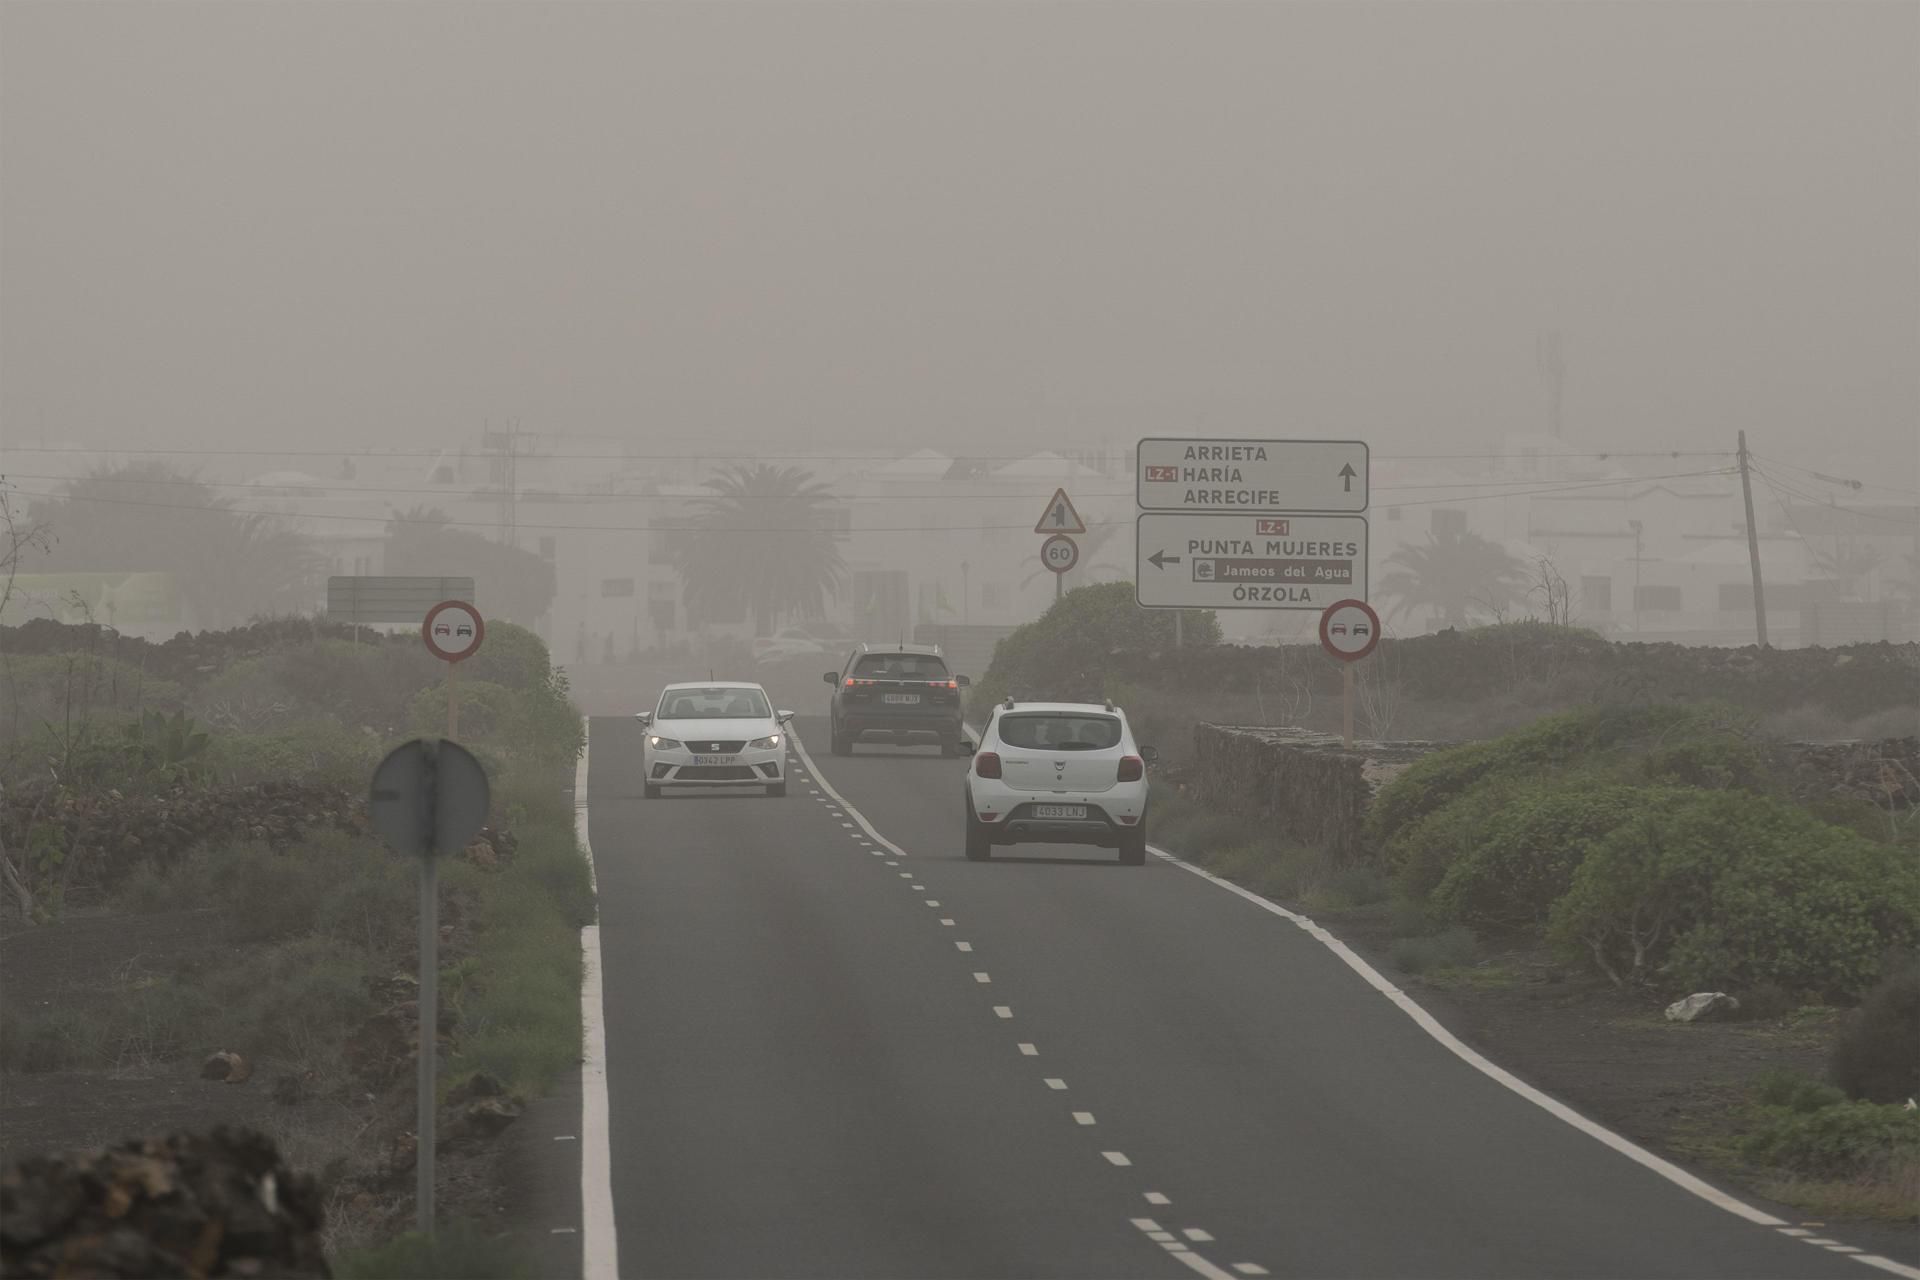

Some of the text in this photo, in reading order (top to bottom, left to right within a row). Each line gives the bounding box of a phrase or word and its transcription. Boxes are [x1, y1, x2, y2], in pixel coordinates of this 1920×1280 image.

[1184, 446, 1268, 462] ARRIETA
[1146, 467, 1177, 481] LZ-1
[1183, 465, 1242, 482] HARÍA
[1184, 489, 1280, 505] ARRECIFE
[1258, 522, 1288, 534] LZ-1
[1050, 547, 1070, 560] 60
[1188, 540, 1358, 557] PUNTA MUJERES
[1223, 565, 1350, 579] Jameos del Agua
[1232, 584, 1312, 602] ÓRZOLA
